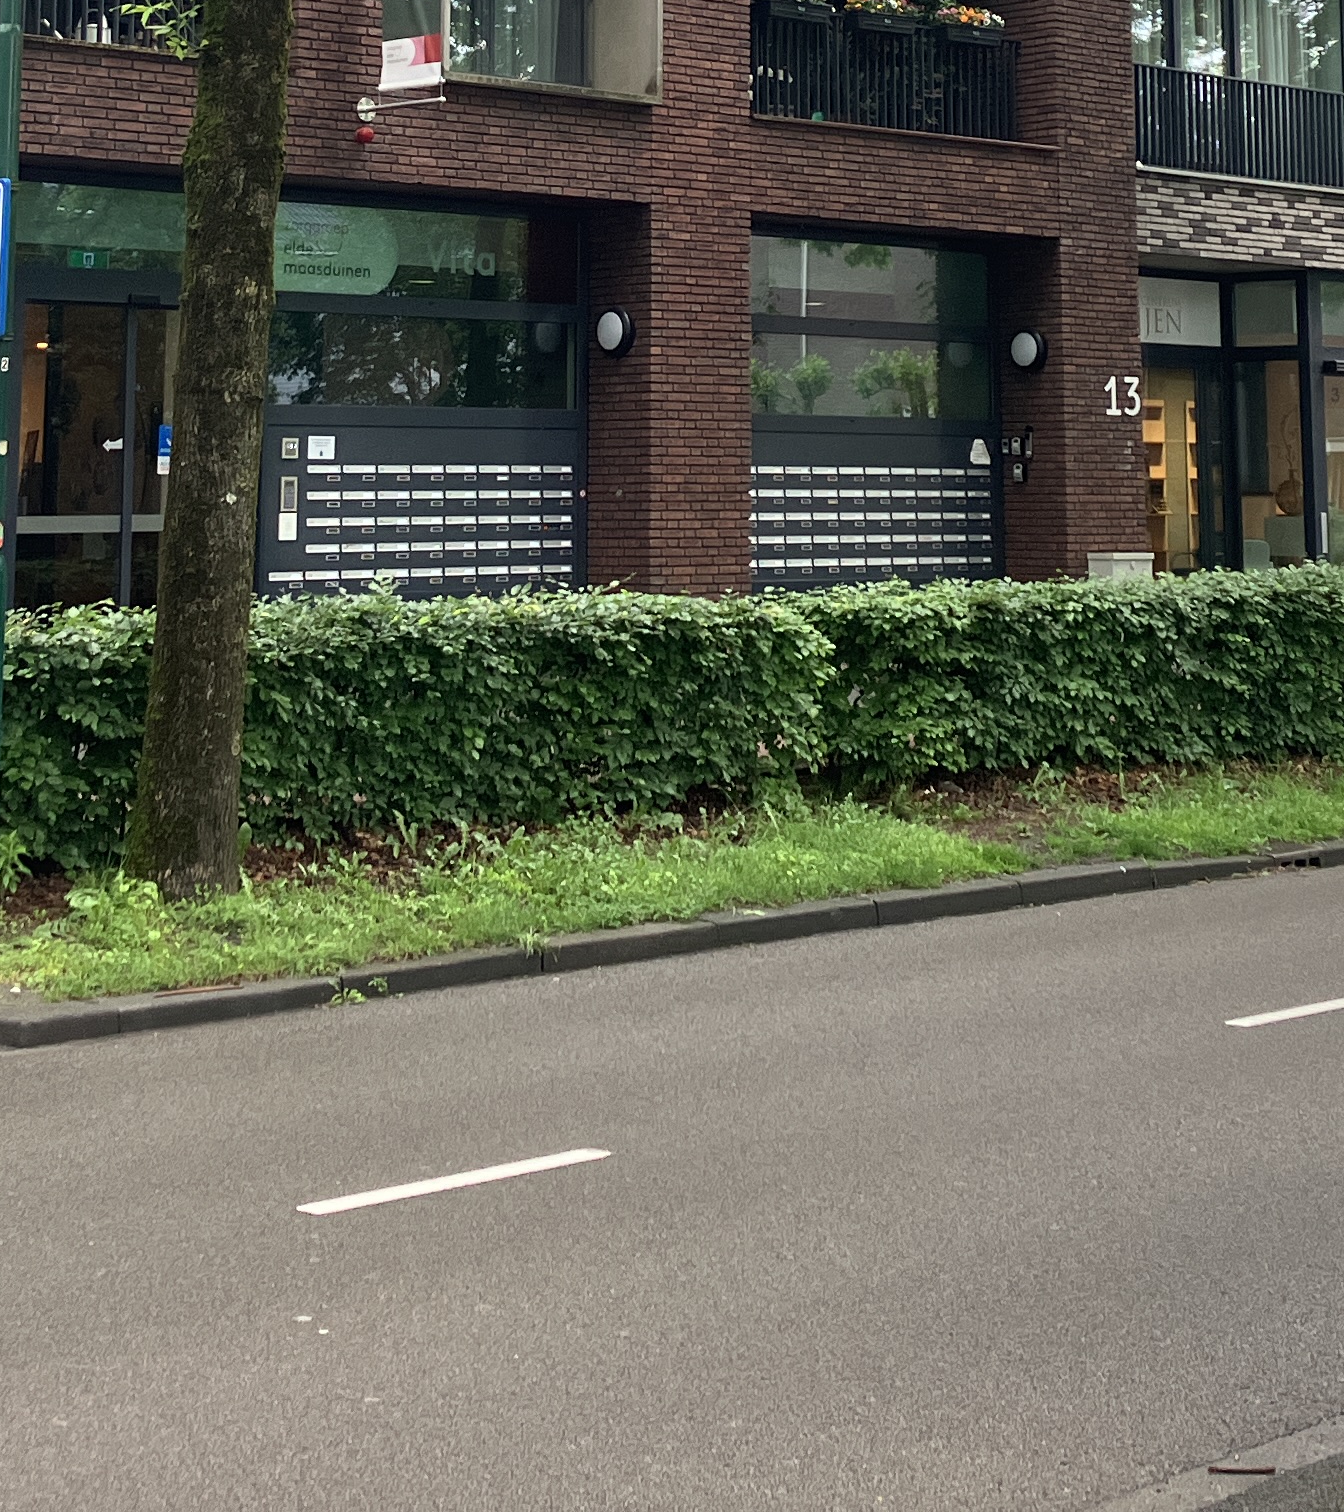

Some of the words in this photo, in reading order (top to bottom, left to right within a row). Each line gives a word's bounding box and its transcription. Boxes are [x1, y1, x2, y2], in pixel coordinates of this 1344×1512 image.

[283, 260, 372, 279] maasduinen
[426, 236, 497, 277] Vita
[1103, 375, 1141, 416] 13
